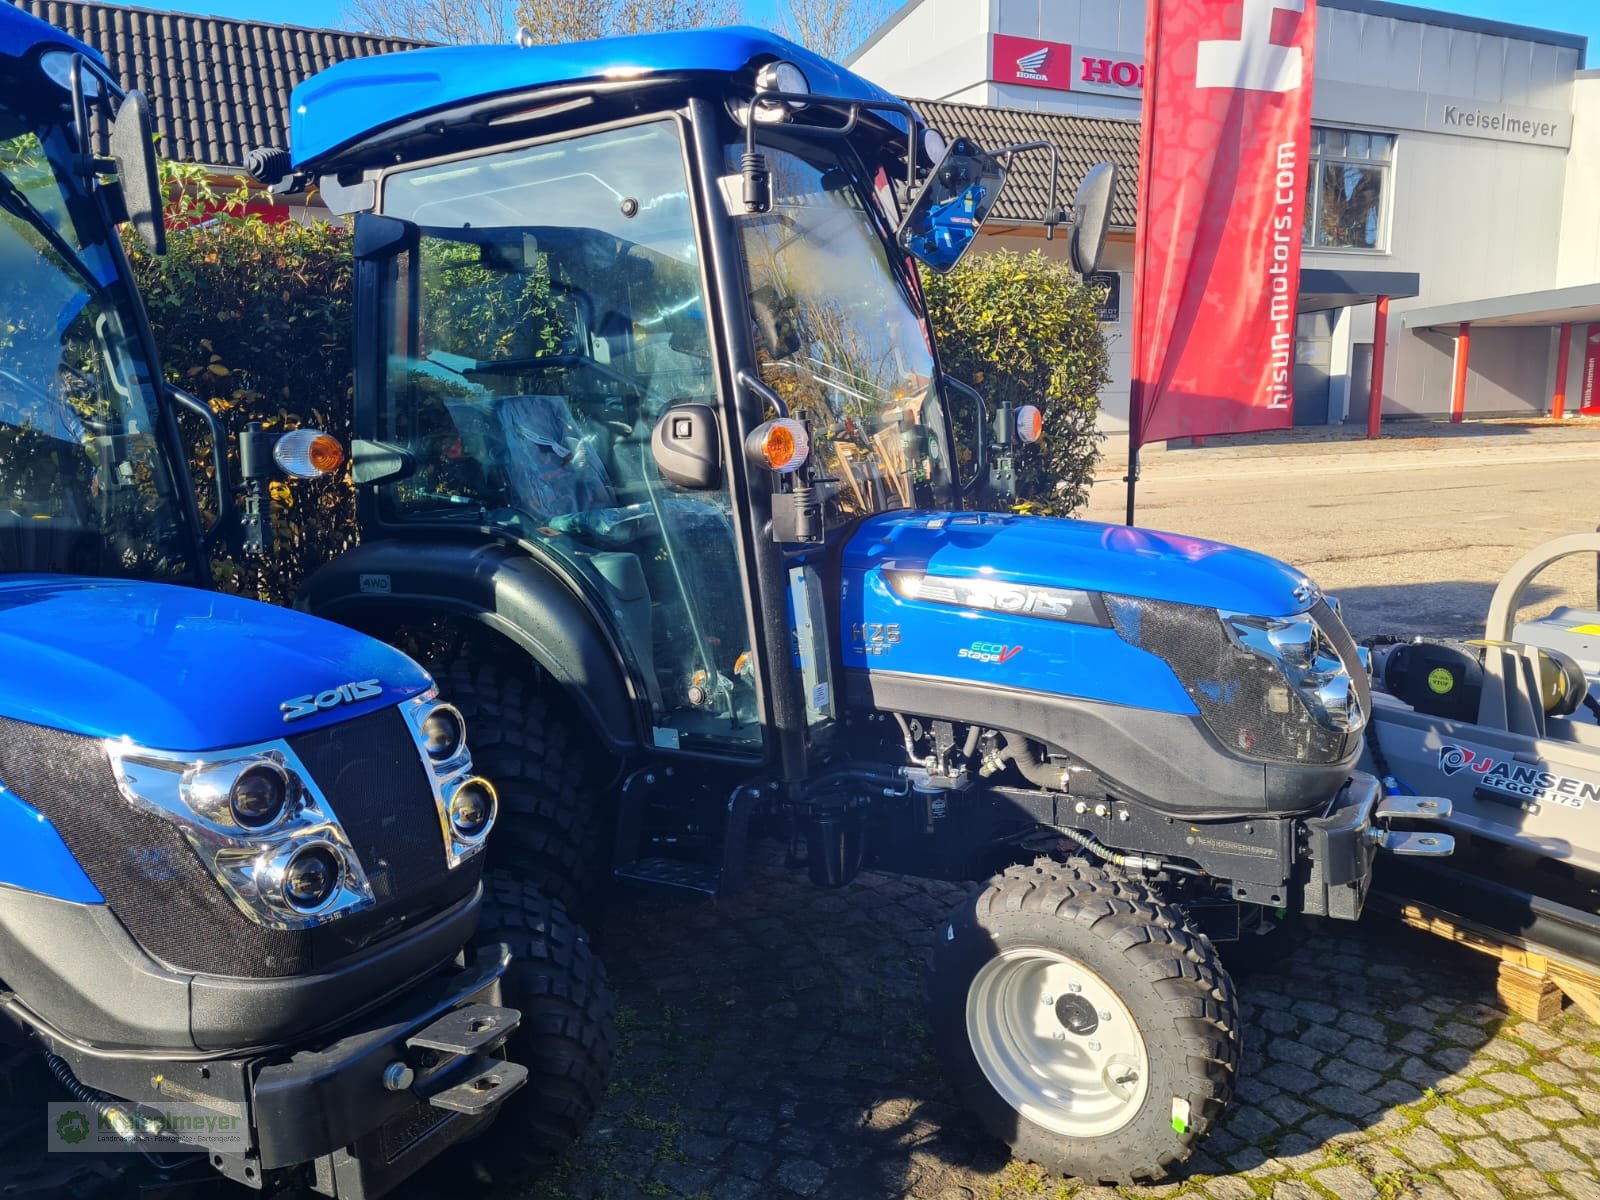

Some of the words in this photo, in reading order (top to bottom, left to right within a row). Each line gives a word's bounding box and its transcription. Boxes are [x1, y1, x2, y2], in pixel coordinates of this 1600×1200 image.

[1016, 71, 1048, 81] HONDA
[1081, 57, 1145, 89] HO
[1443, 104, 1557, 138] Kreiselmeyer
[1267, 141, 1296, 409] hisun-motors.com
[363, 578, 387, 589] 4WD
[971, 642, 1002, 653] ECO
[1472, 758, 1600, 801] JANSEN
[1483, 776, 1546, 798] EFGCH
[1551, 794, 1582, 808] 175
